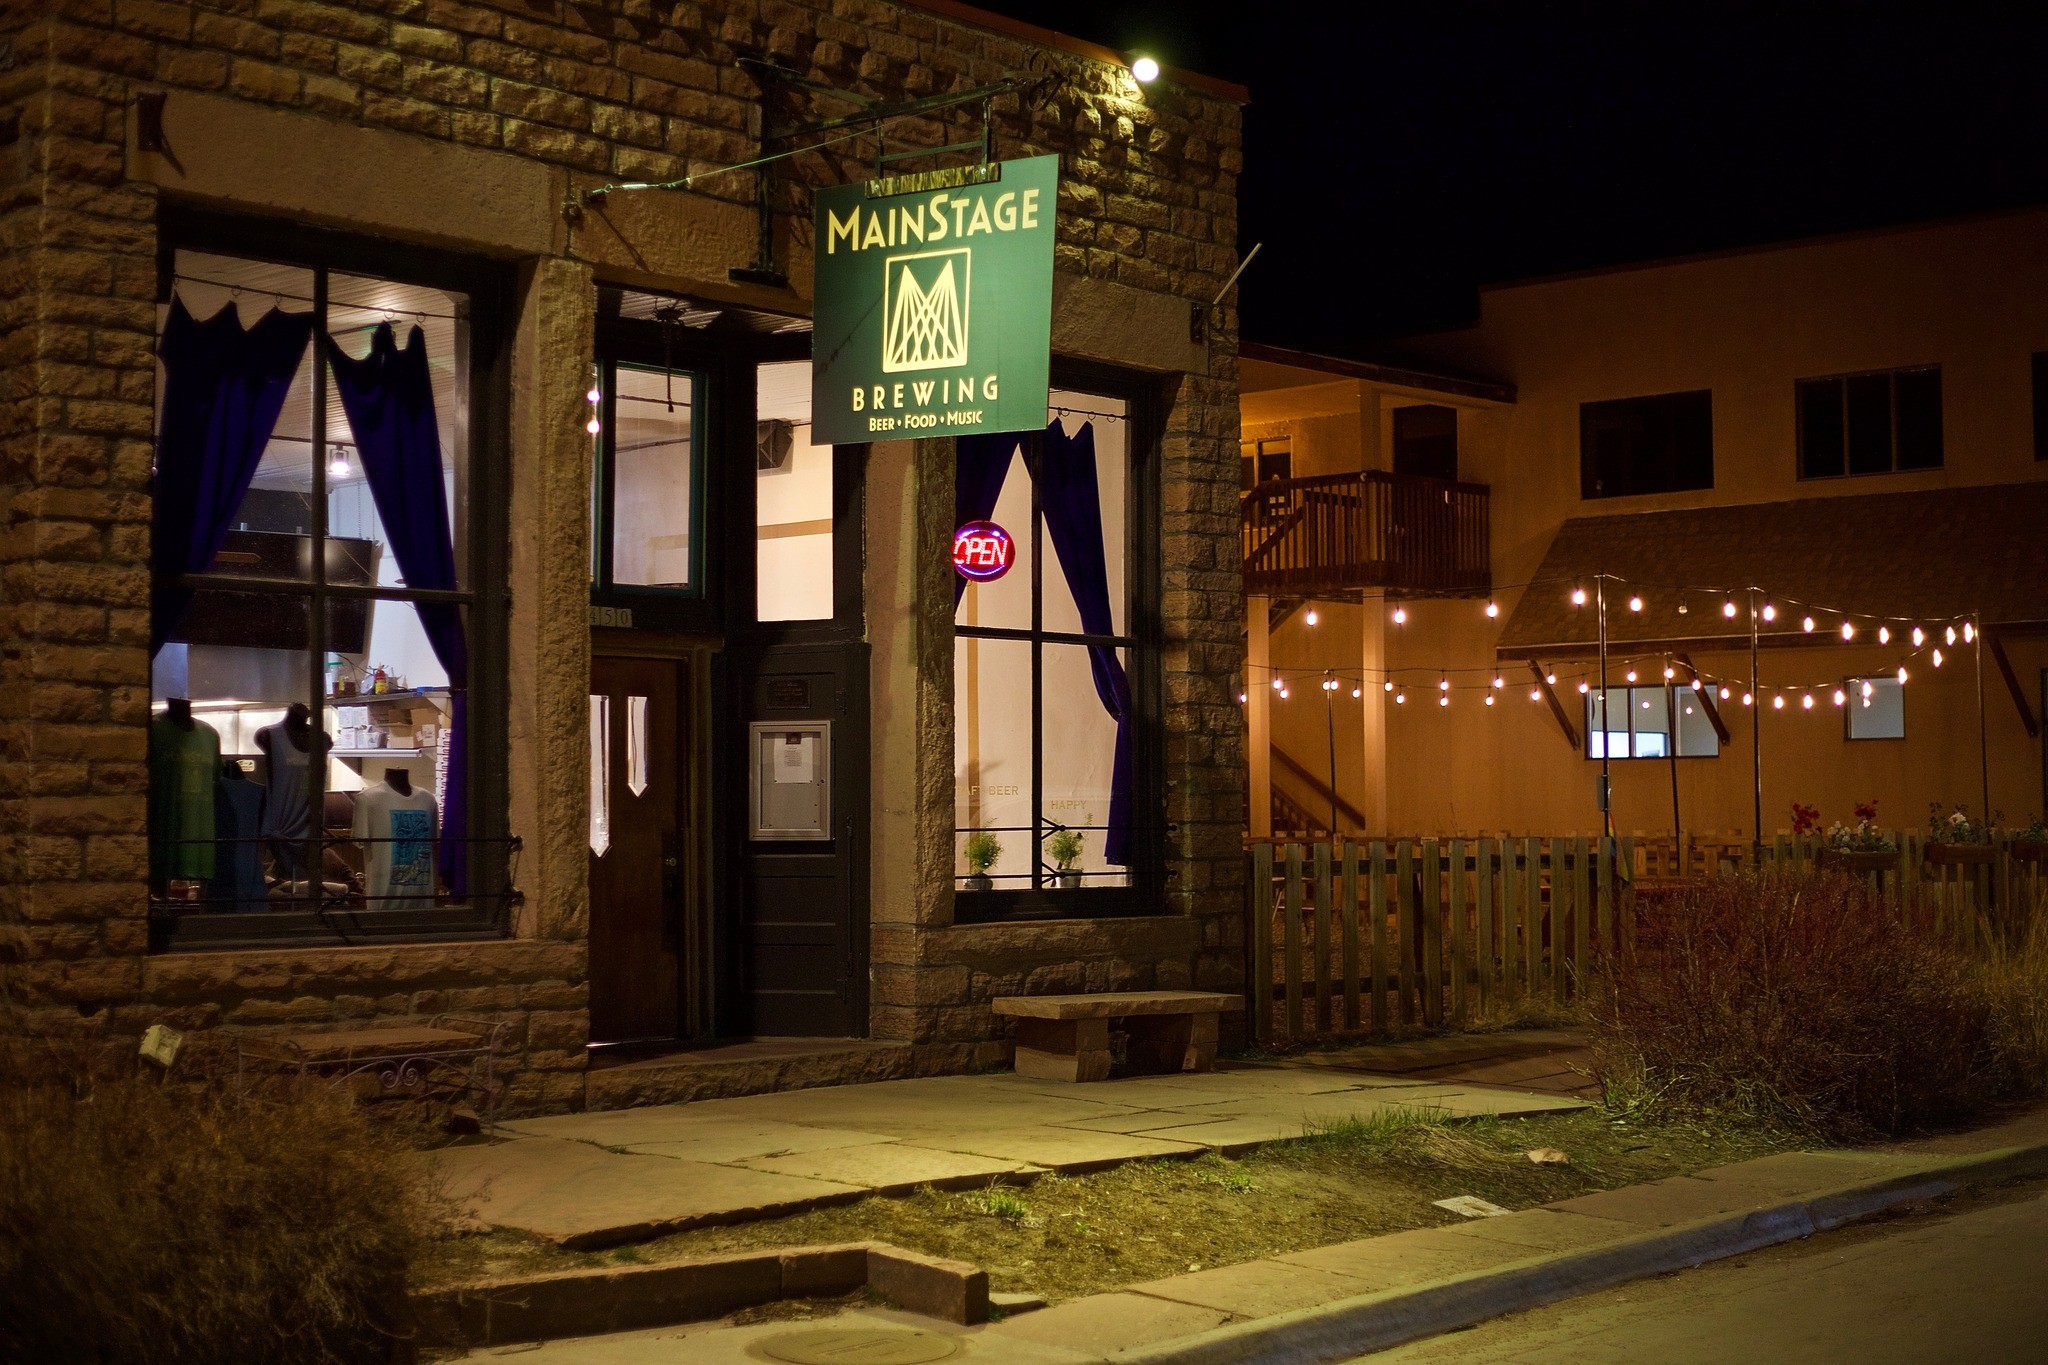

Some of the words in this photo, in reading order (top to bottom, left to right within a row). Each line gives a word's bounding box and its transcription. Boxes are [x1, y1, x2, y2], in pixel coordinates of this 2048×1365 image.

[828, 189, 1040, 254] MAINSTAGE
[852, 375, 998, 411] BREWING
[869, 417, 895, 432] BEER
[904, 413, 937, 429] FOOD
[947, 410, 983, 426] MUSIC
[953, 537, 1008, 565] OPEN
[988, 785, 1019, 796] BEER
[1051, 800, 1087, 810] HAPPY
